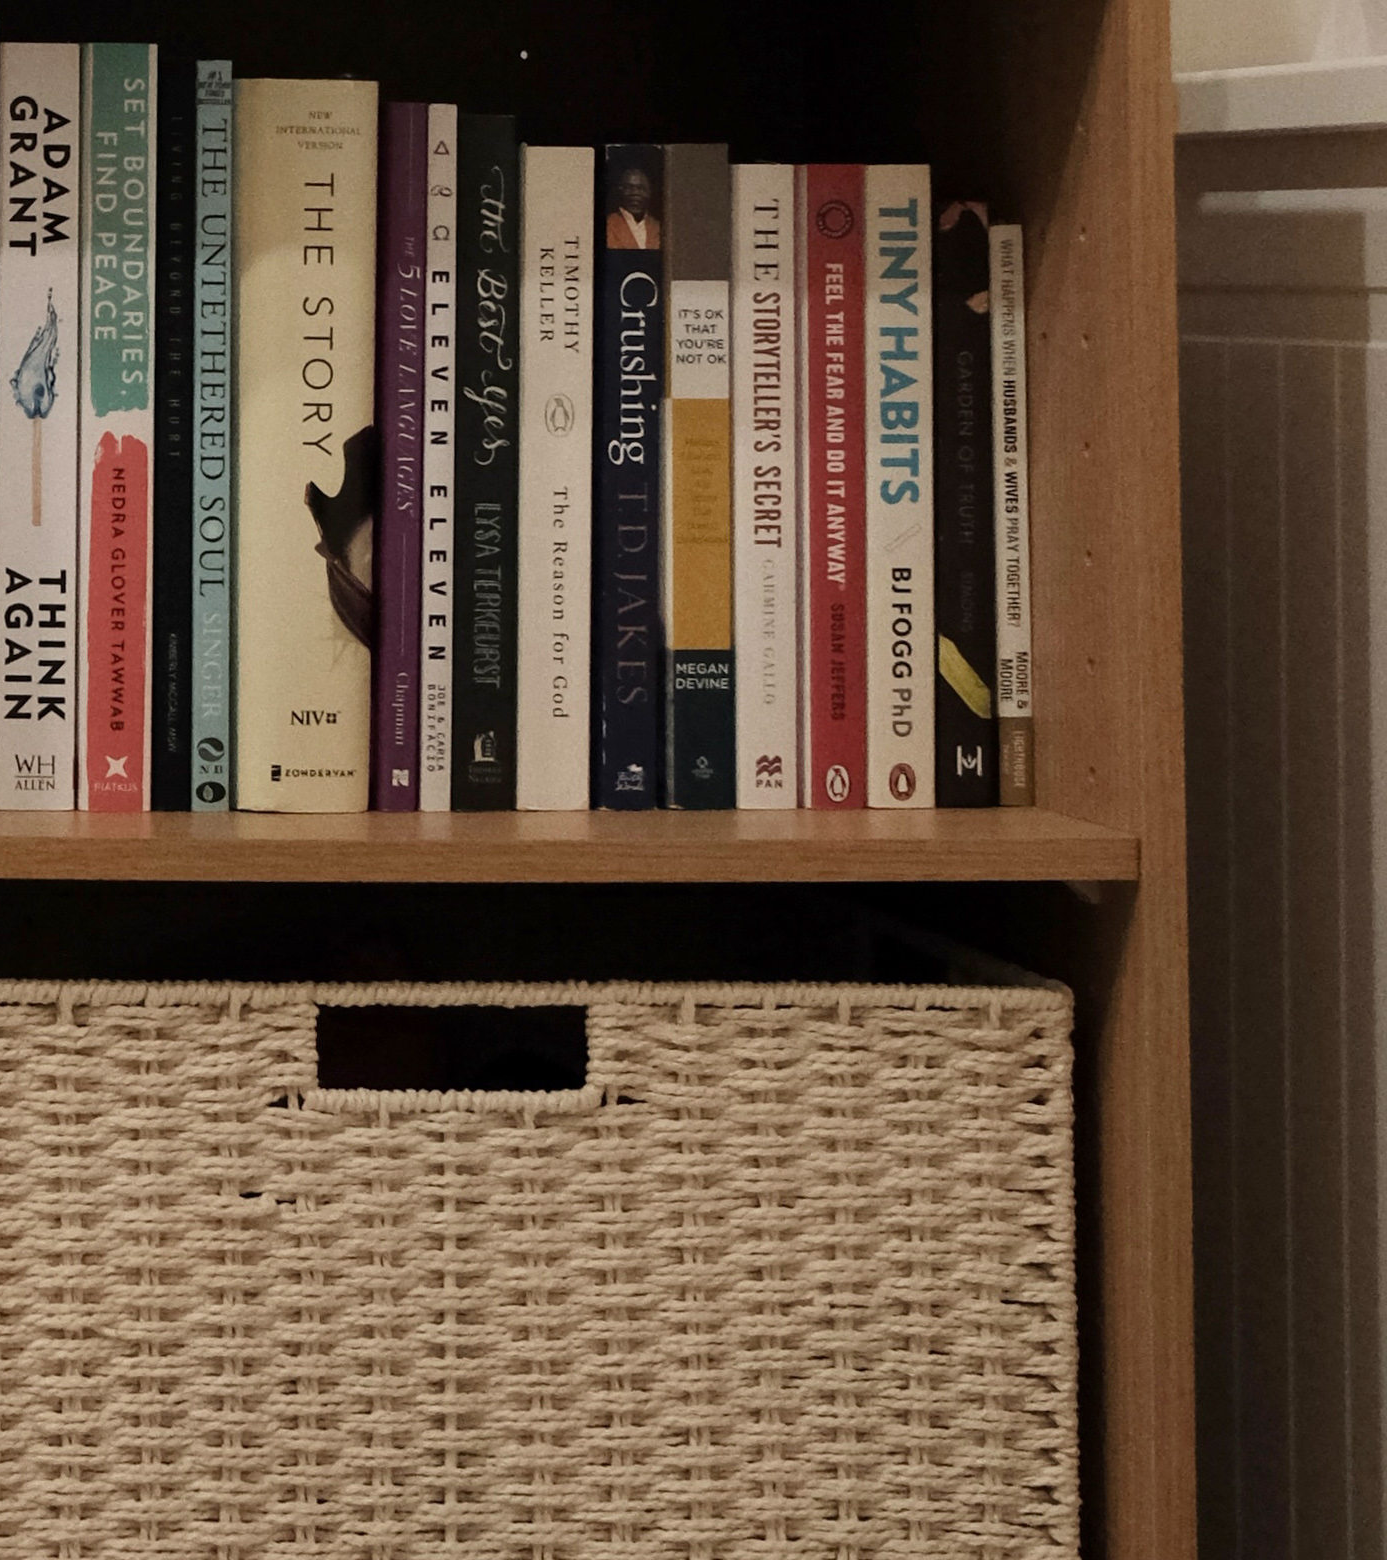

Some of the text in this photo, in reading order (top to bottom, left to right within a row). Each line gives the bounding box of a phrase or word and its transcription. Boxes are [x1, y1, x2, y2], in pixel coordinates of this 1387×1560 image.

[123, 78, 146, 138] SET
[275, 125, 361, 136] INTERNATIONAL
[298, 141, 344, 150] VERSION
[308, 111, 332, 120] NEW
[9, 96, 39, 256] GRANT
[43, 108, 72, 244] ADAM
[202, 119, 227, 197] THE
[94, 131, 118, 340] FIND PEACE
[302, 173, 333, 456] THE STORY
[539, 247, 556, 342] KELLER
[564, 236, 580, 354] TIMOTHY
[678, 309, 724, 320] IT'S OK
[825, 263, 844, 304] FEEL
[200, 214, 227, 481] UNTETHERED
[608, 271, 658, 465] Crushing
[676, 339, 725, 350] YOU'RE
[676, 353, 726, 364] NOT OK
[685, 324, 716, 334] THAT
[826, 311, 845, 347] THE
[879, 199, 919, 505] TINY HABITS
[753, 198, 782, 548] THE STORYTELLER'S SECRET
[827, 353, 845, 400] FEAR
[827, 406, 845, 444] AND
[827, 451, 845, 474] DO
[999, 239, 1021, 628] WHAT HAPPENS WHEN HUSBANDS & WIVES PRAY TOGETHER?
[429, 271, 449, 660] ELEVEN ELEVEN
[827, 480, 845, 498] IT
[199, 495, 225, 597] SOUL
[110, 467, 127, 731] NEDRA GLOVER TAWWAB
[552, 486, 569, 718] The Reason for God
[614, 562, 649, 705] JAKES
[4, 567, 33, 720] AGAIN
[37, 569, 66, 721] THINK
[202, 612, 221, 719] SINGER
[676, 663, 728, 674] MEGAN
[892, 567, 912, 737] BJ FOGG PhD
[676, 678, 728, 689] DEVINE
[15, 755, 55, 775] WH
[15, 780, 55, 791] ALLEN
[285, 768, 355, 778] ZONDERVAN
[755, 780, 783, 789] PAN
